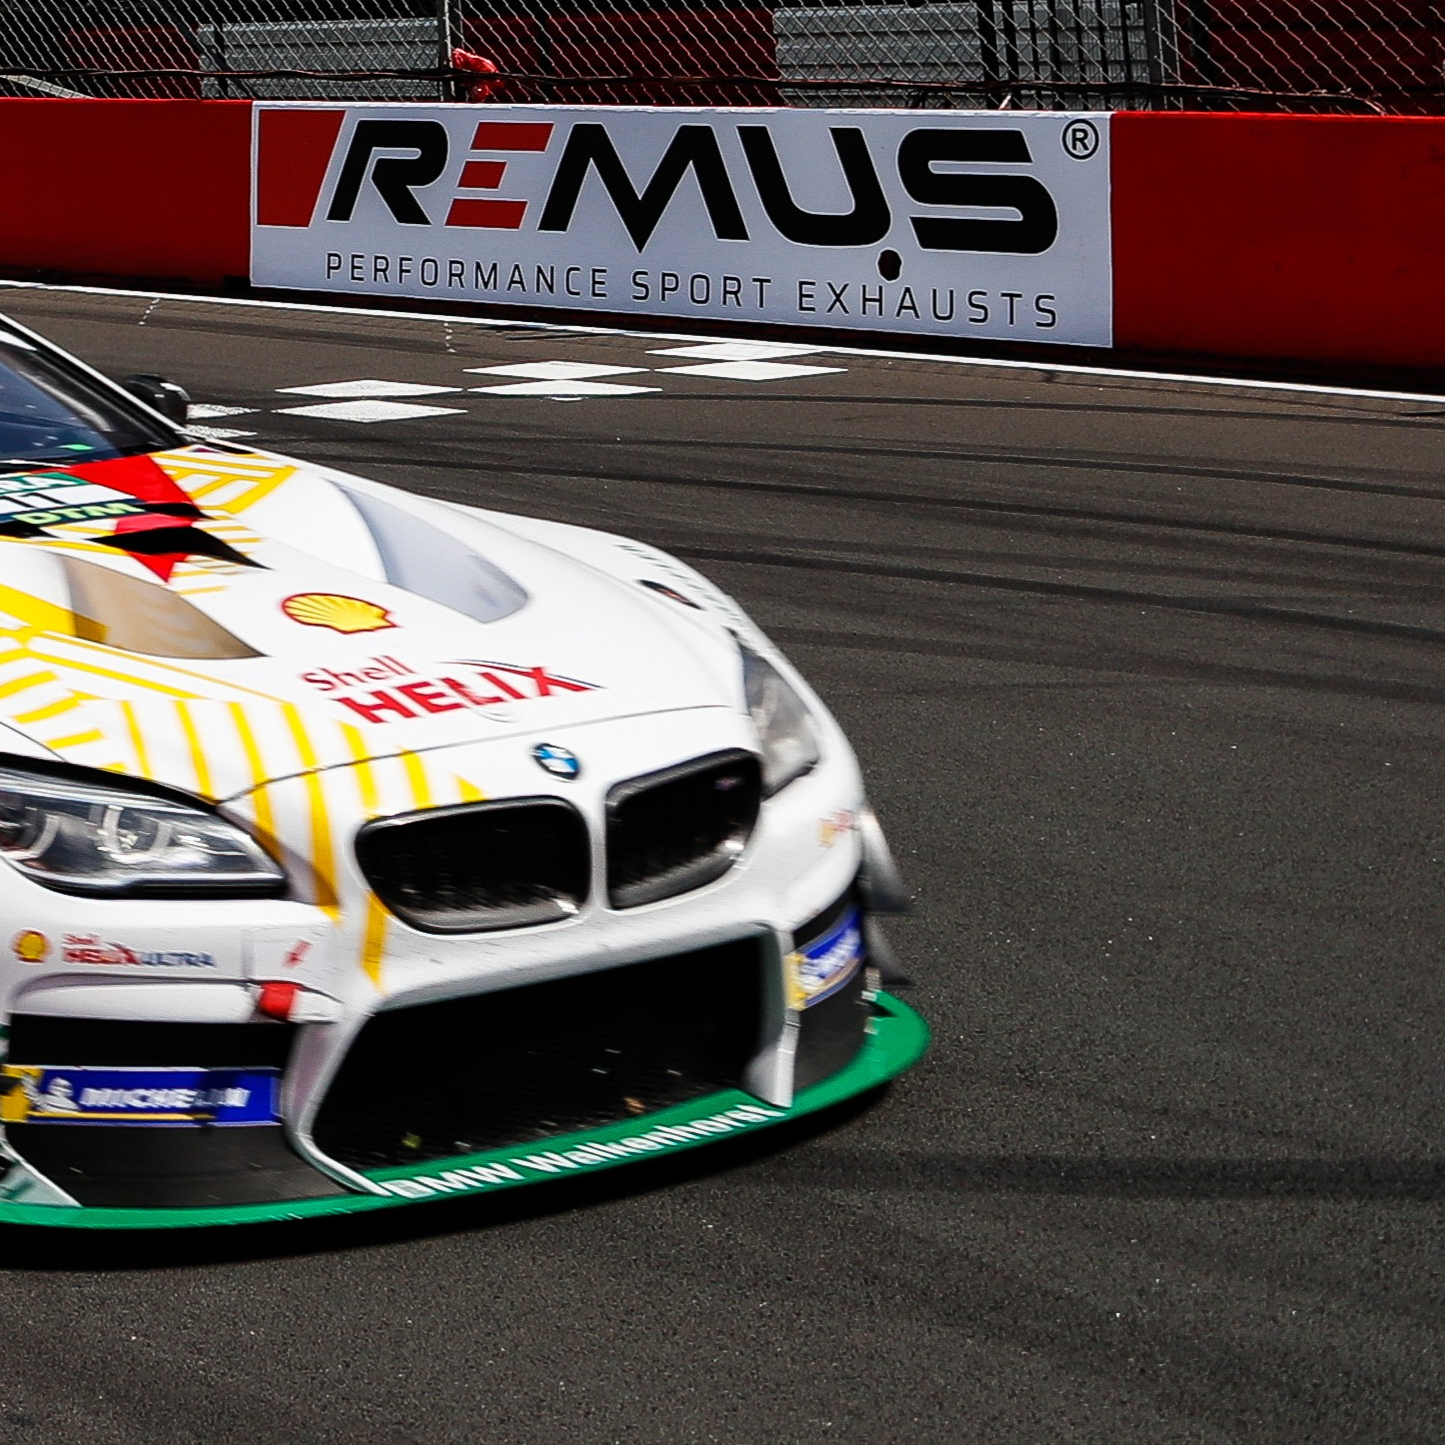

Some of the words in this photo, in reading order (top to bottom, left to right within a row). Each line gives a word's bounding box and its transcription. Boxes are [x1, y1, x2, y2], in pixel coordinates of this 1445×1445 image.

[326, 117, 1059, 254] REMUS
[325, 250, 609, 300] PERFORMANCE
[630, 269, 773, 311] SPORT
[797, 279, 1058, 329] EXHAUSTS
[11, 502, 147, 525] DTM
[300, 655, 415, 692] Shell
[334, 665, 595, 724] HELIX
[78, 1087, 252, 1108] MICHELIN
[511, 1103, 791, 1174] Walkenhorst
